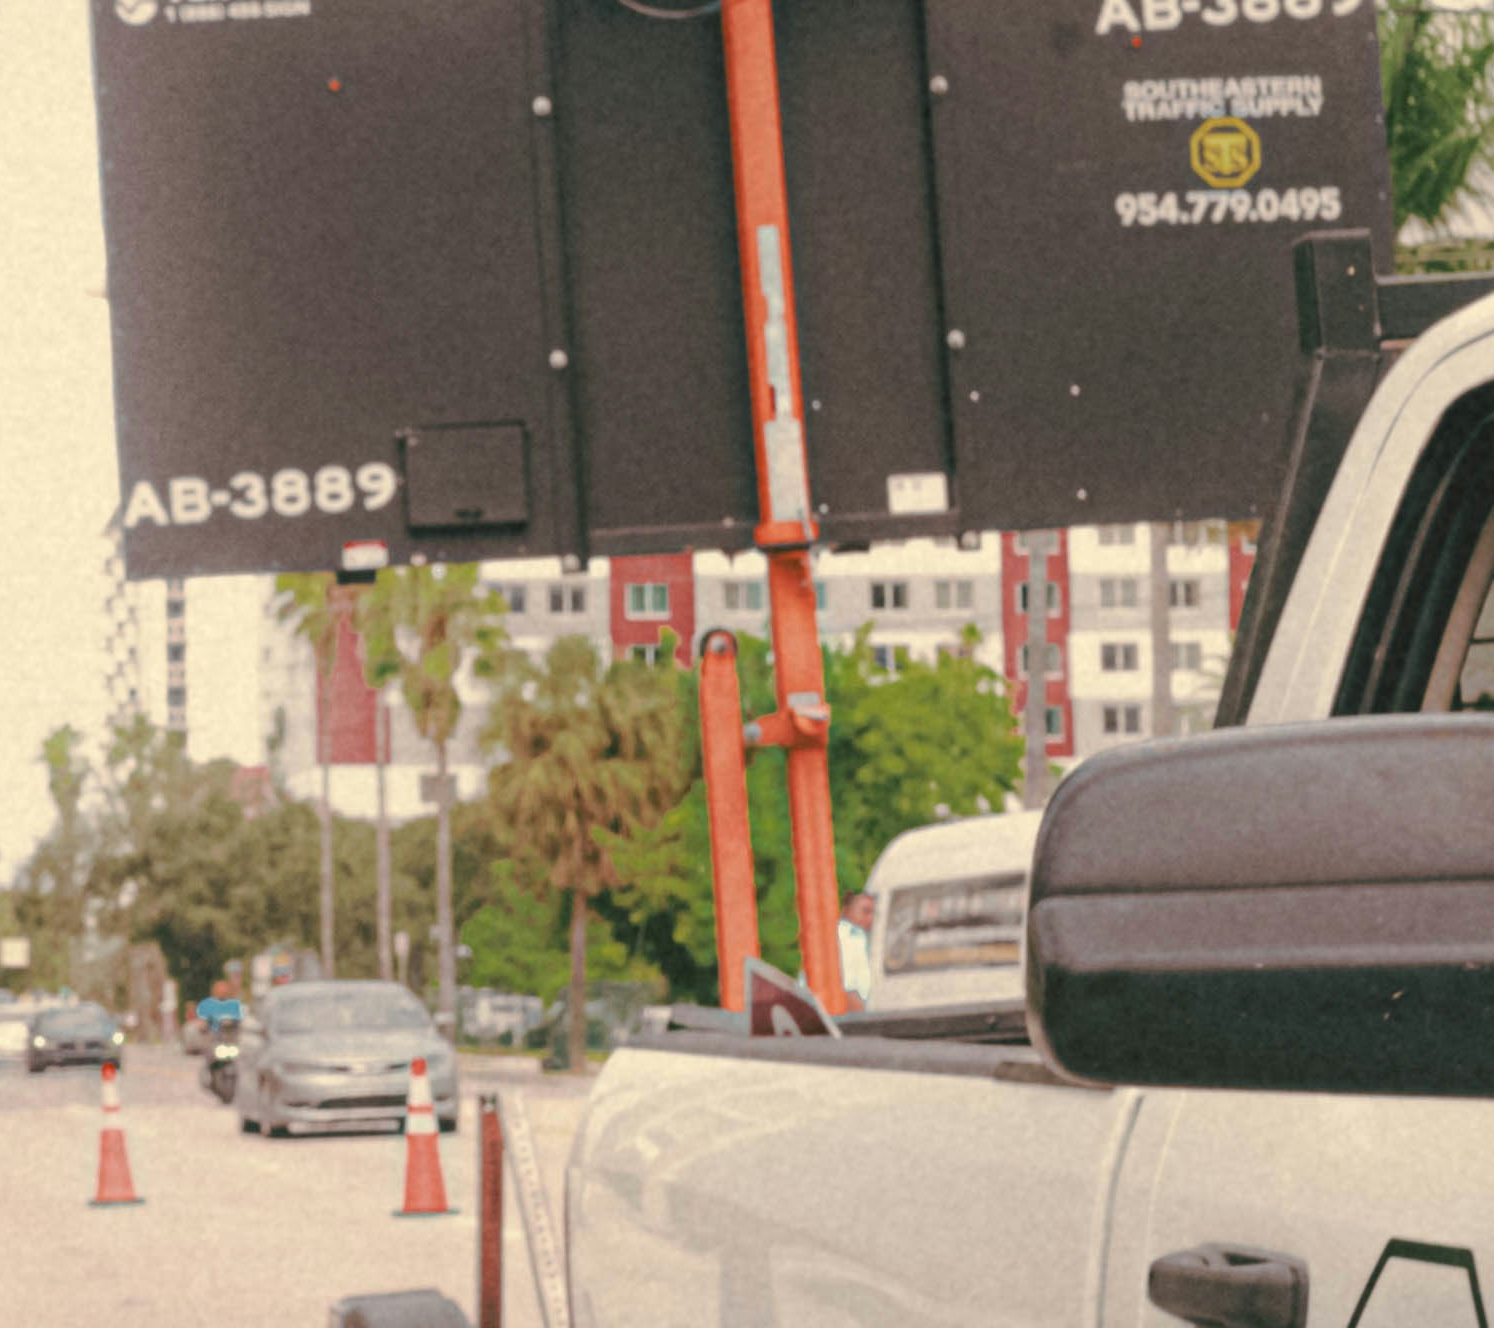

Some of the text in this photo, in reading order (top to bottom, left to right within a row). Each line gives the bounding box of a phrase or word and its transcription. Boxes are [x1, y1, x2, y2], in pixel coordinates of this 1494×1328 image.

[1122, 75, 1323, 102] SOUTHEASTERN
[1122, 94, 1324, 123] TRAFFIC SUPPLY
[1114, 186, 1343, 227] 954.779.0495
[123, 461, 398, 529] AB-3889
